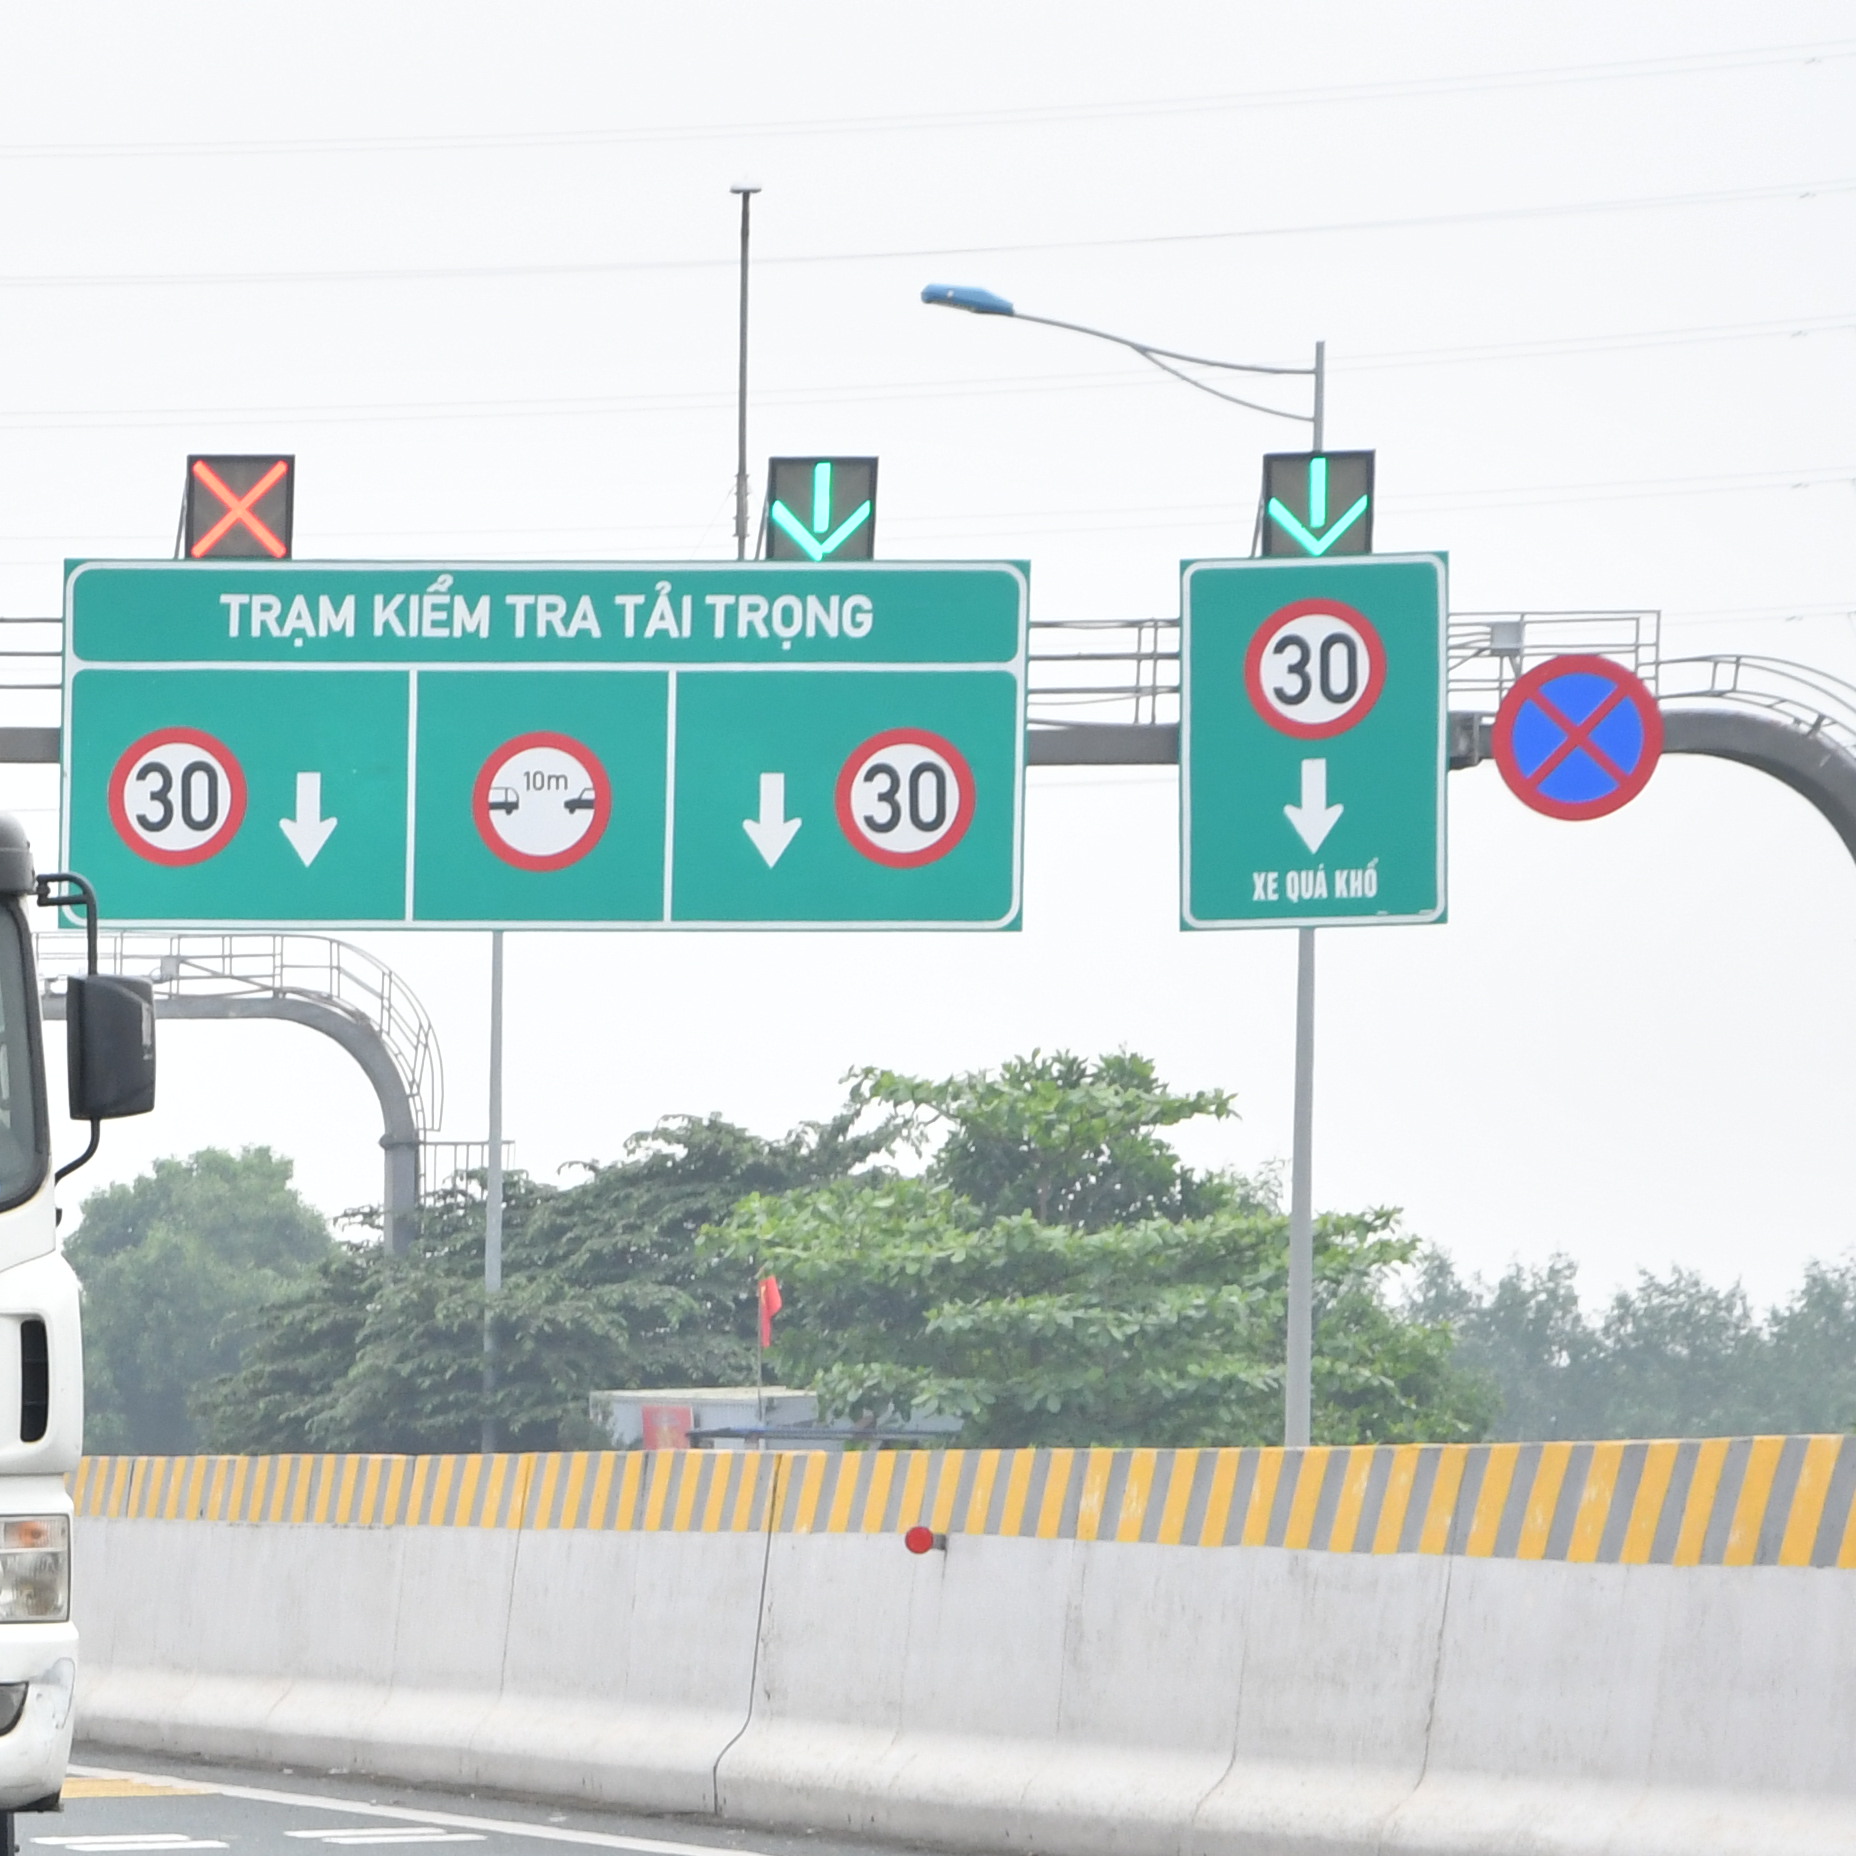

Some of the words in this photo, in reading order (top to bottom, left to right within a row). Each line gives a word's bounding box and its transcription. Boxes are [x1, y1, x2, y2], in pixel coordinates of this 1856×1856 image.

[219, 593, 356, 648] TRẠM
[373, 574, 492, 638] KIỂM
[505, 594, 602, 638] TRA
[614, 579, 693, 639] TẢI
[704, 593, 874, 651] TRỌNG
[1272, 632, 1359, 707] 30
[135, 760, 220, 833] 30
[523, 770, 569, 791] 10m
[862, 761, 948, 835] 30
[1252, 871, 1279, 902] XE
[1285, 862, 1328, 903] QUÁ
